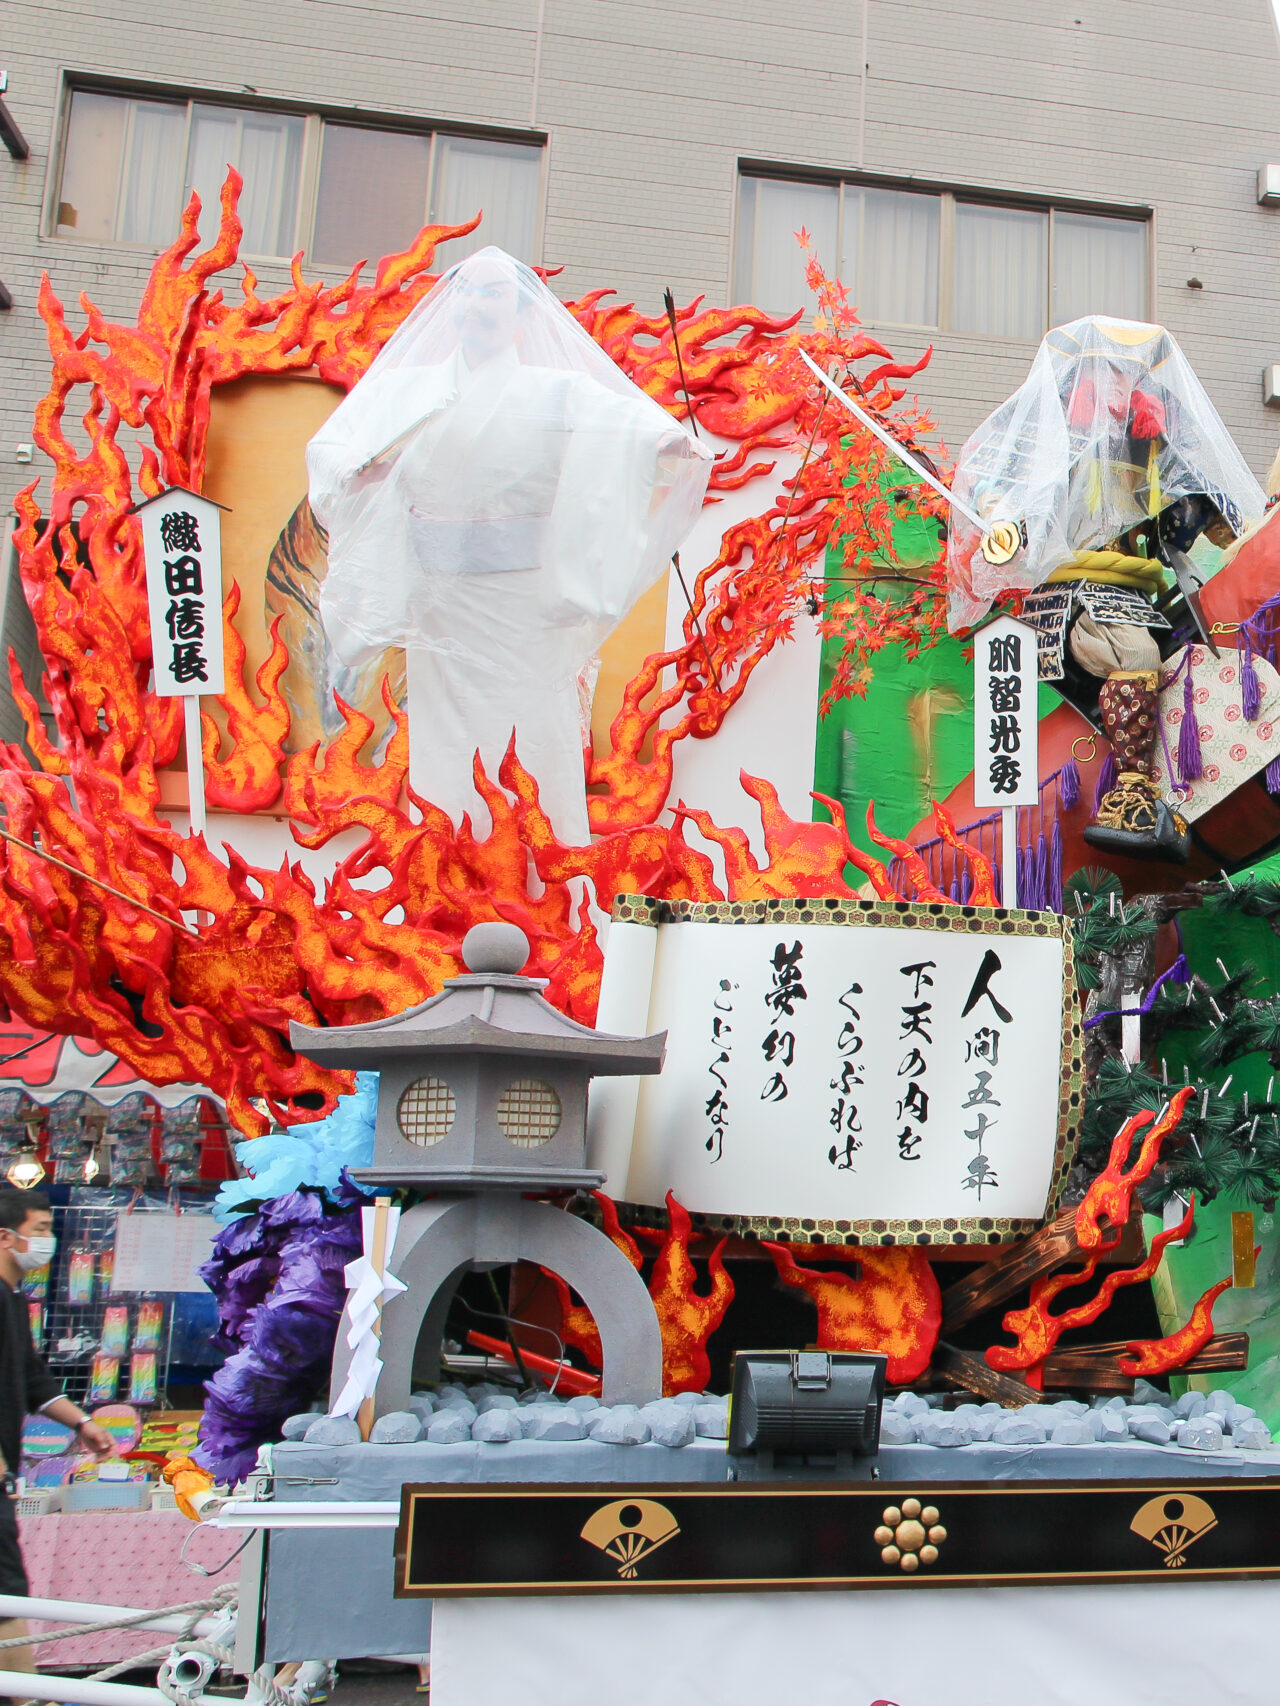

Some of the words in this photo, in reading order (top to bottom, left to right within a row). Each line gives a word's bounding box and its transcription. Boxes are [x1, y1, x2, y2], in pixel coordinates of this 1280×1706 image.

[160, 511, 209, 684] 織田信長
[988, 634, 1022, 795] 明智光秀
[704, 978, 741, 1165] ごとくなり
[760, 940, 808, 1103] 夢幻の
[827, 982, 865, 1174] くらぶれば
[895, 960, 937, 1162] 下天の内を
[960, 948, 1014, 1202] 人間五十年
